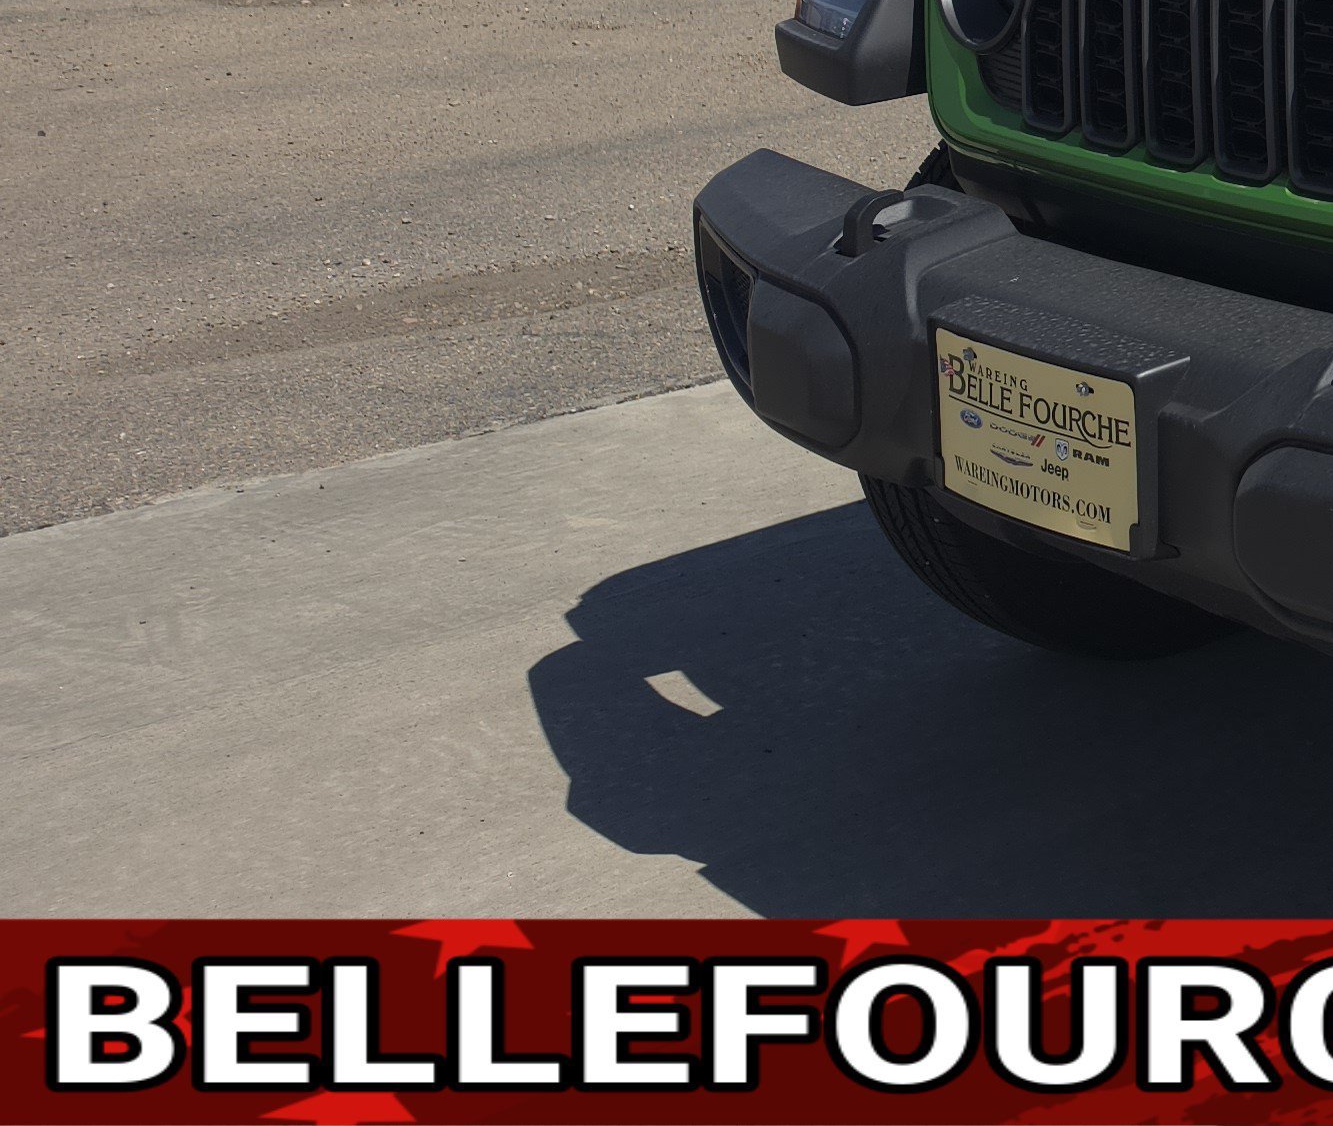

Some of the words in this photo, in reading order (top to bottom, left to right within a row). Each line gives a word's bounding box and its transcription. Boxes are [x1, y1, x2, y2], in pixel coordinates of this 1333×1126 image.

[968, 359, 1028, 392] WAREING
[948, 352, 1013, 415] BELLE
[1019, 391, 1132, 449] FOURCHE
[1040, 458, 1069, 481] Jeep
[1072, 448, 1110, 467] RAM
[954, 454, 1111, 523] WAREINGMOTORS.COM
